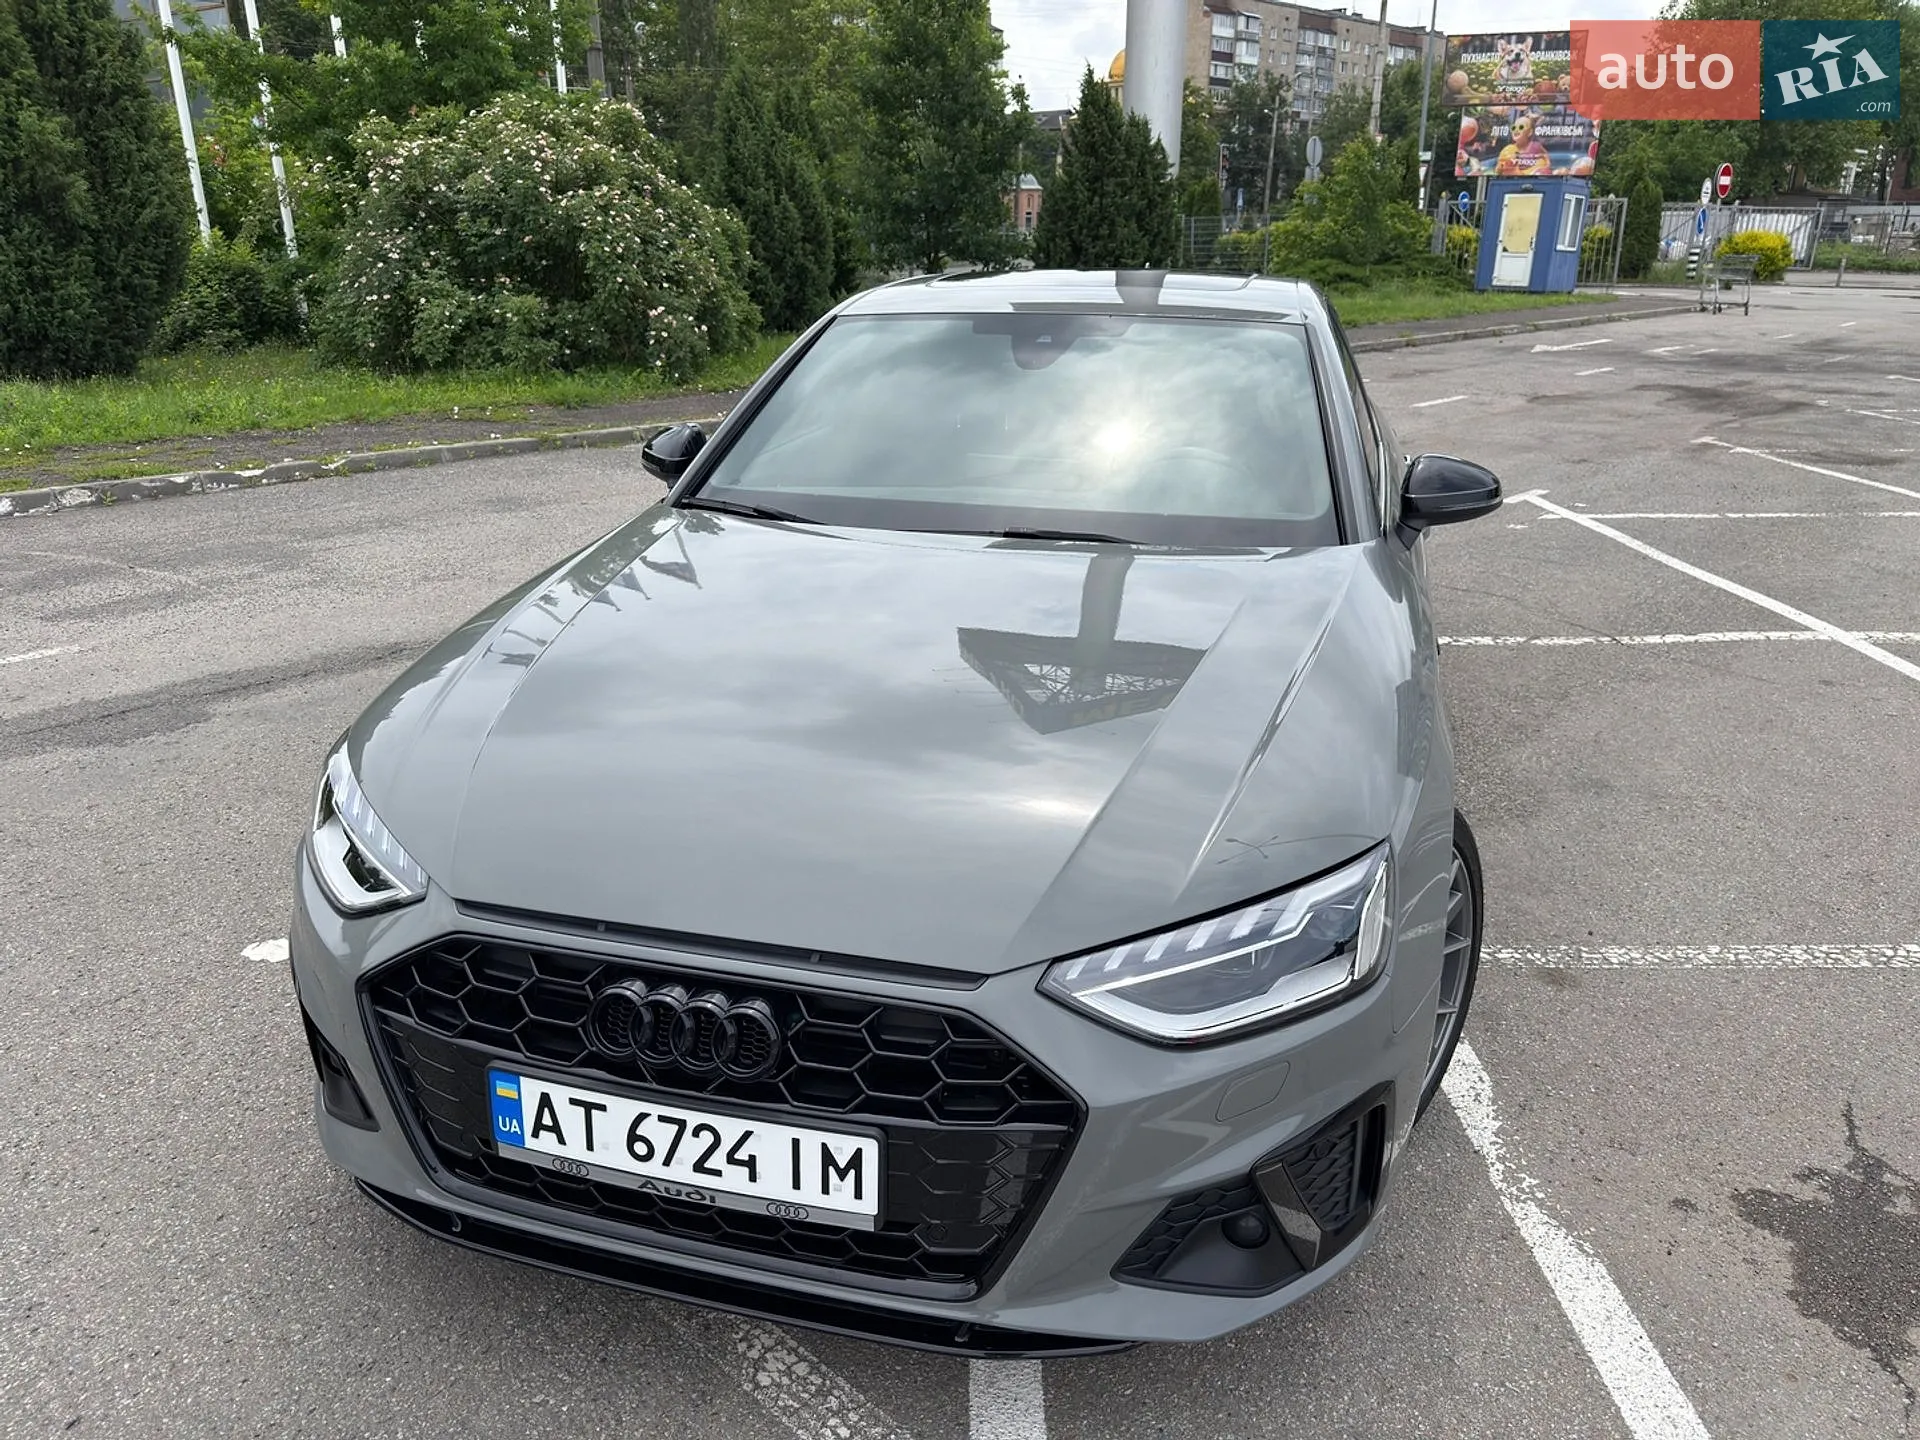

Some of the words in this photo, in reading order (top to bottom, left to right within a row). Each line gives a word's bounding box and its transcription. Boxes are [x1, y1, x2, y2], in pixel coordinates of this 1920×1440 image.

[498, 1115, 521, 1135] UA
[531, 1091, 607, 1152] AT
[626, 1112, 757, 1183] 6724
[791, 1137, 863, 1200] IM
